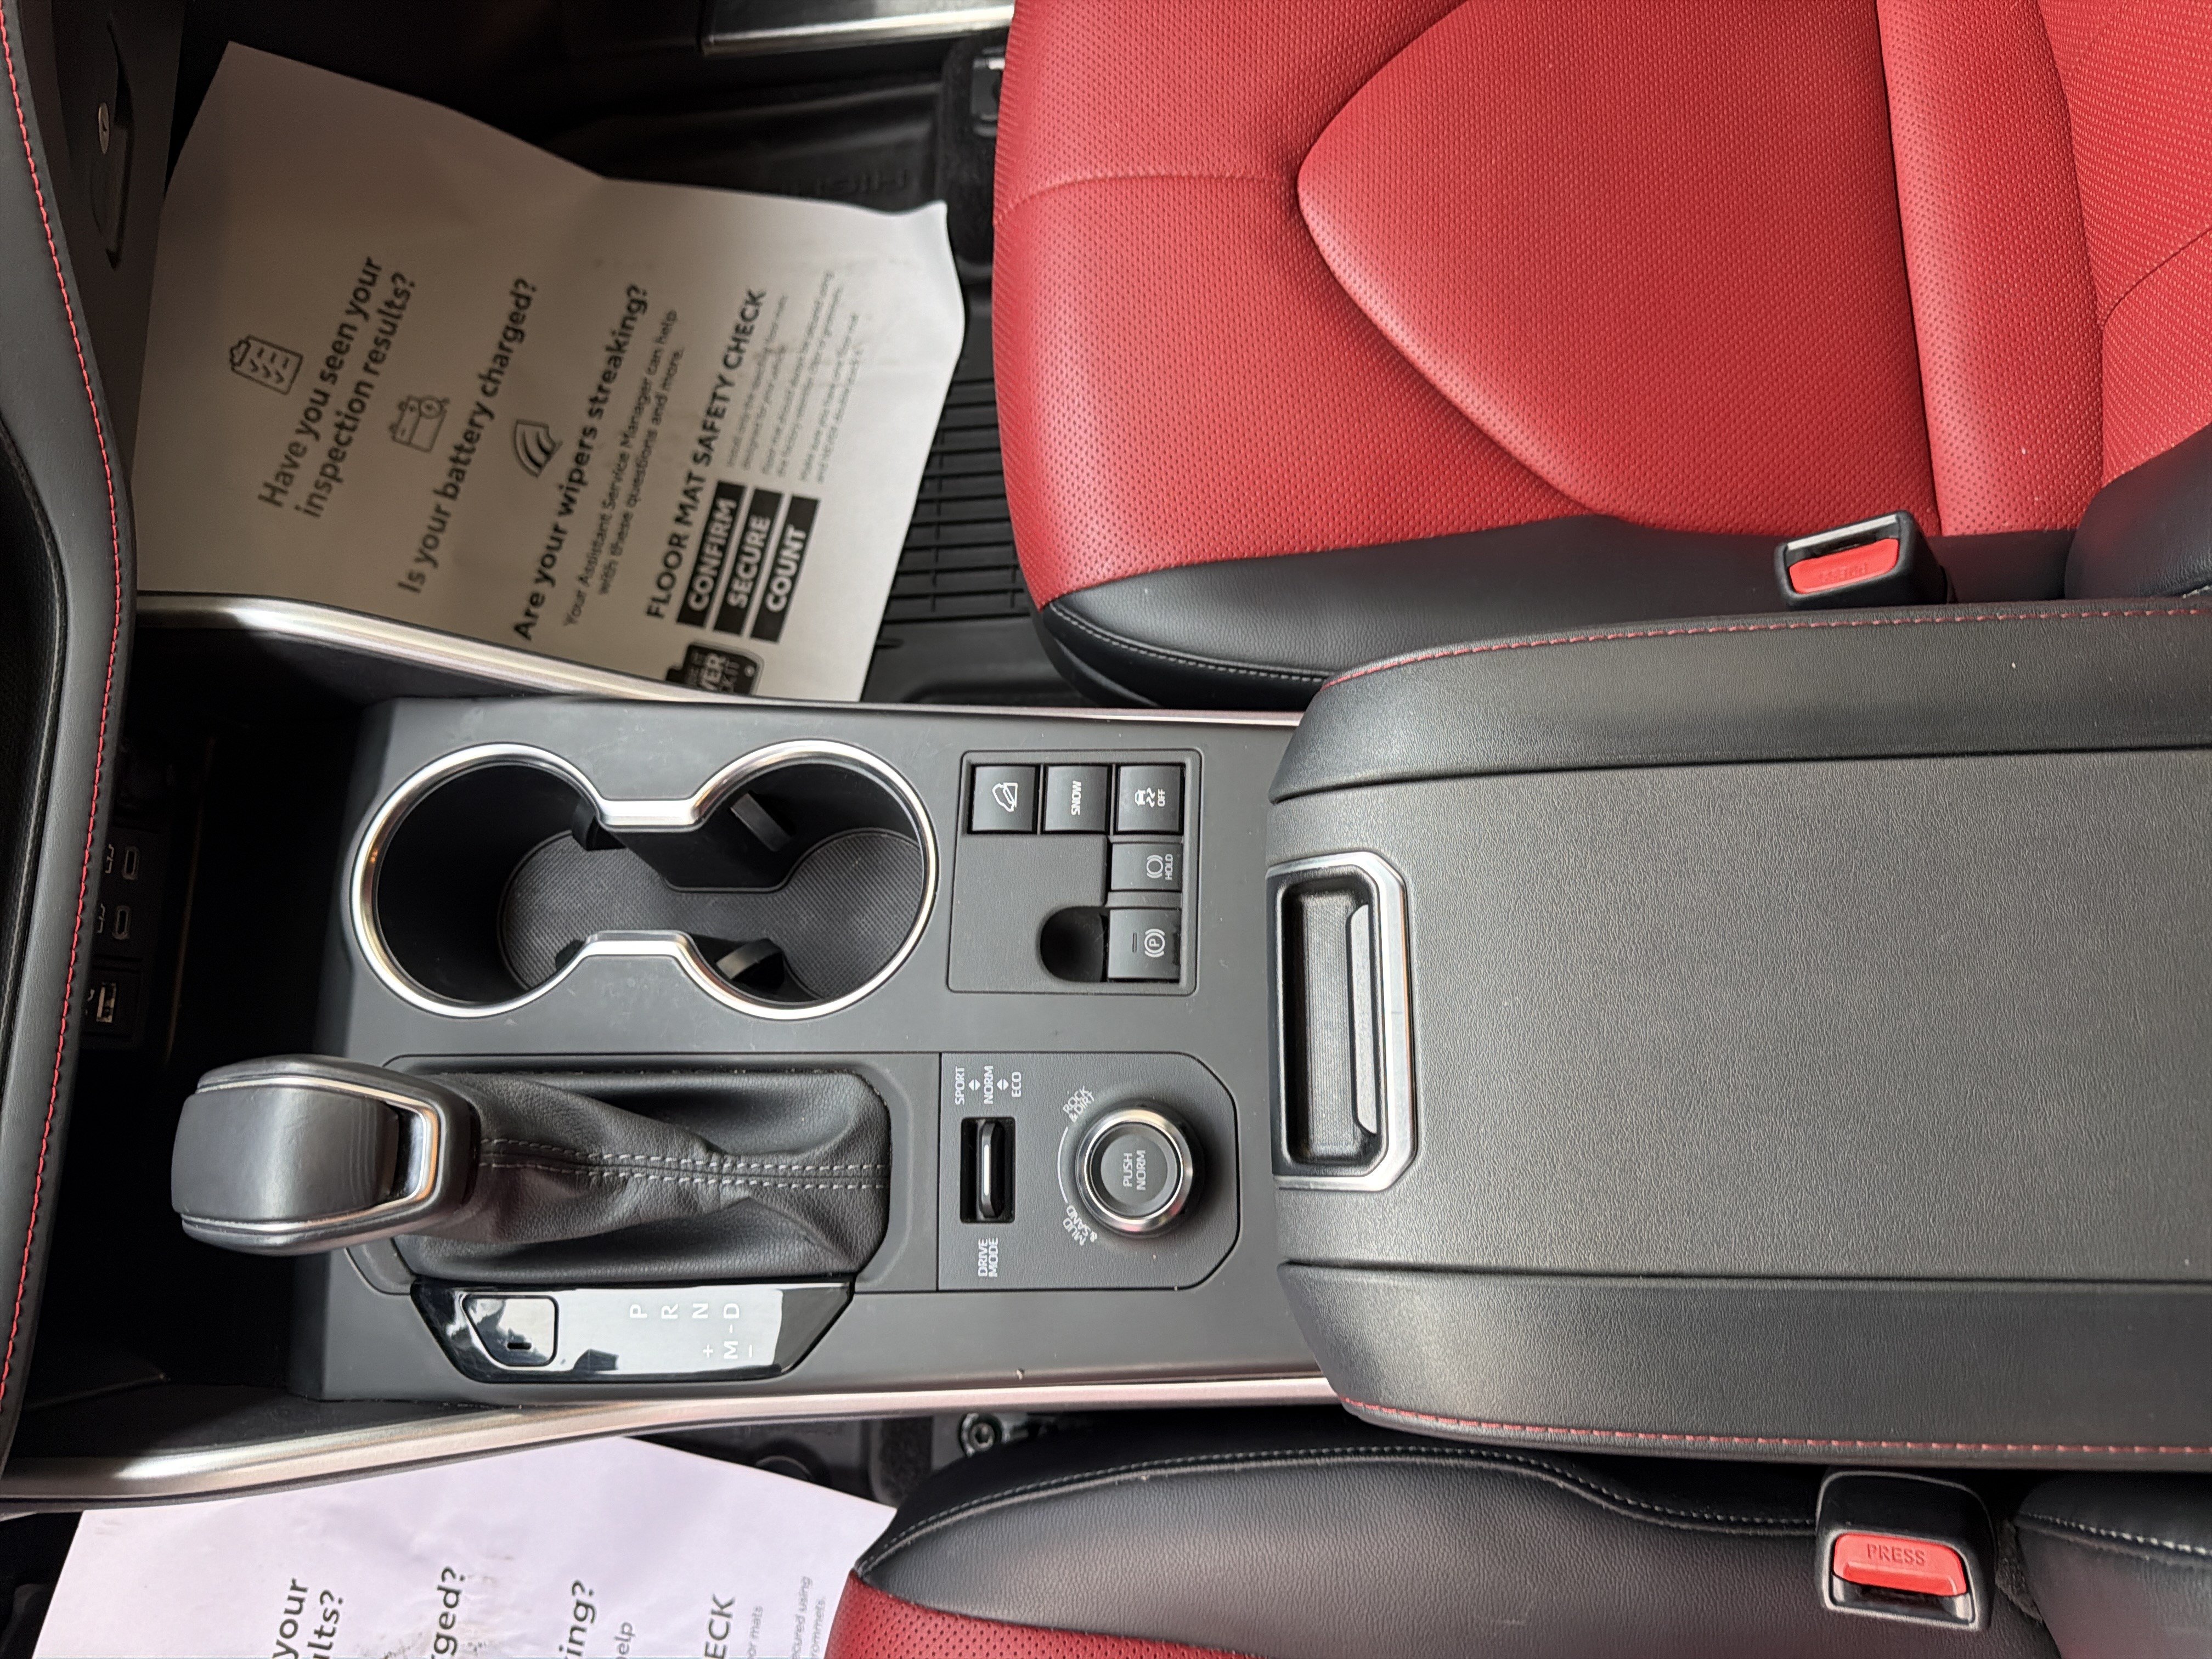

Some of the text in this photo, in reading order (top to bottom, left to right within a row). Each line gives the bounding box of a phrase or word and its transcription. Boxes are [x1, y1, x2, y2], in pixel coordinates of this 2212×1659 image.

[257, 256, 382, 508] Have you seen your
[294, 271, 416, 518] inspection results?
[397, 278, 537, 594] Is your battery charged?
[645, 532, 689, 619] FLOOR
[673, 470, 706, 527] MAT
[691, 374, 733, 467] SAFETY
[721, 290, 765, 371] CHECK
[512, 284, 648, 641] Are your wipers streaking?
[689, 499, 737, 610] CONFIRM
[729, 517, 771, 607] SECURE
[767, 526, 806, 611] COUNT
[1071, 780, 1082, 815] SNOW
[1157, 788, 1165, 808] OFF
[1165, 854, 1173, 881] HOLD
[955, 1066, 965, 1105] SPORT
[984, 1065, 994, 1104] NORM
[1011, 1071, 1022, 1097] ECO
[1063, 1085, 1085, 1114] ROCK
[1074, 1091, 1094, 1115] DIRT
[1122, 1153, 1133, 1187] PUSH
[1136, 1150, 1146, 1190] NORM
[1063, 1218, 1086, 1246] MUD
[1066, 1205, 1091, 1237] SAND
[978, 1239, 988, 1277] DRIVE
[988, 1237, 998, 1277] MODE
[630, 1305, 647, 1318] P
[662, 1304, 678, 1319] R
[692, 1304, 708, 1318] N
[724, 1304, 739, 1318] D
[724, 1341, 738, 1359] M
[1867, 1544, 1926, 1565] PRESS
[431, 1566, 465, 1659] ged?
[798, 1576, 813, 1612] using
[272, 1578, 309, 1659] your
[558, 1579, 597, 1659] ing?
[747, 1605, 763, 1659] or mats
[613, 1622, 636, 1659] elp
